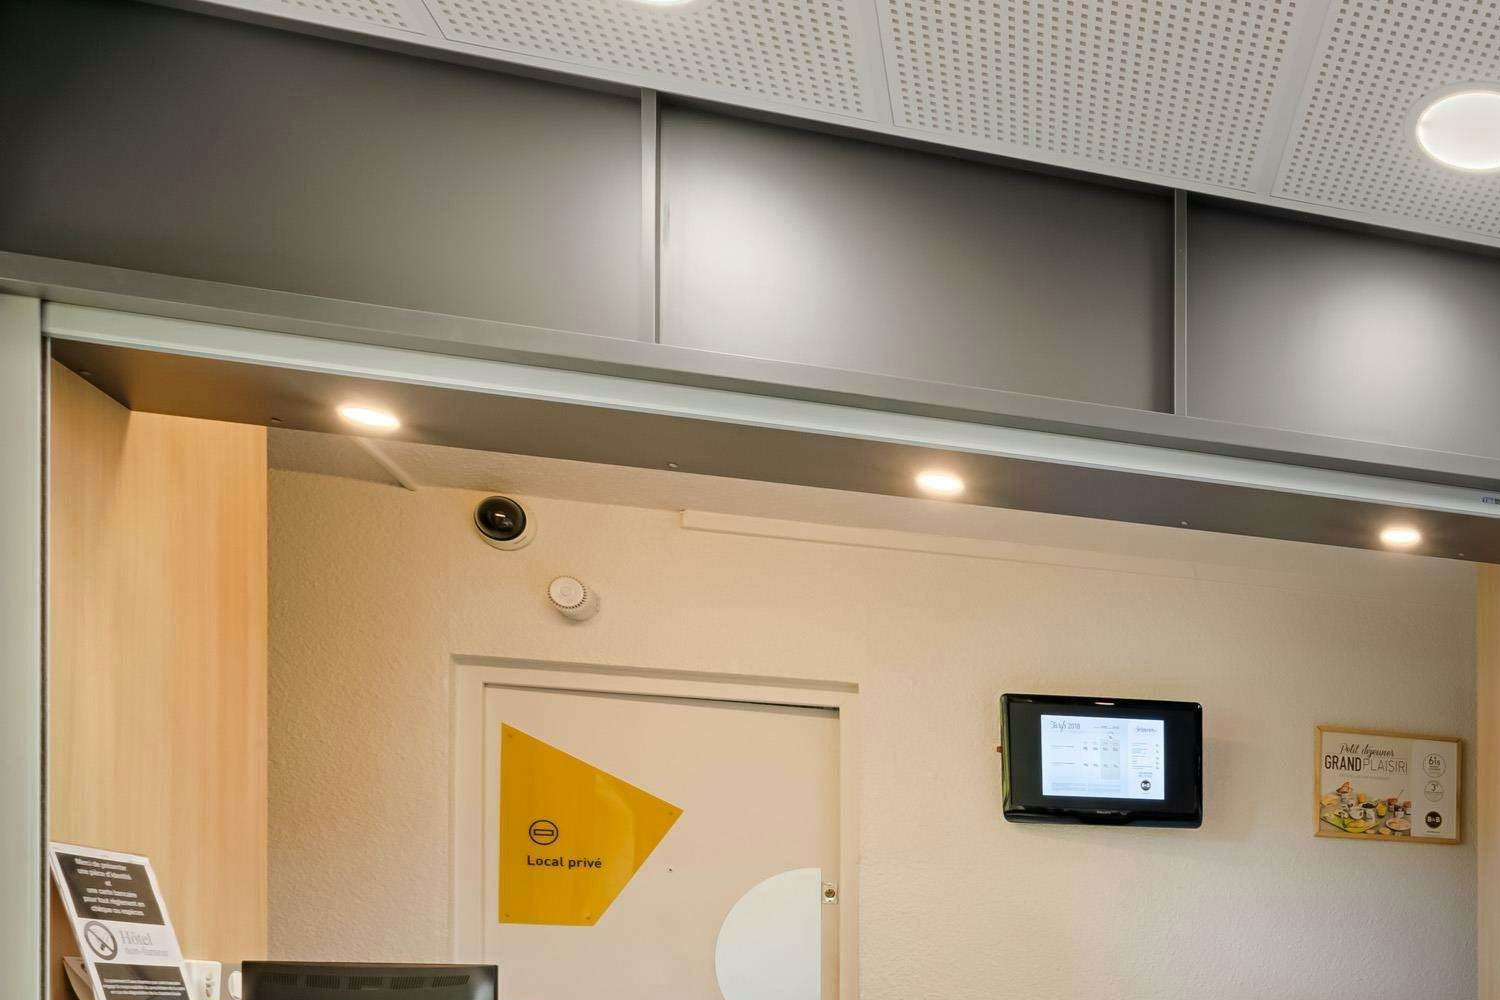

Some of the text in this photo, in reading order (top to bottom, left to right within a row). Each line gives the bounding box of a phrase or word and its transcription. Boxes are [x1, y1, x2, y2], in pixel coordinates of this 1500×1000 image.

[1324, 754, 1361, 772] GRAND
[527, 855, 602, 869] Local privé
